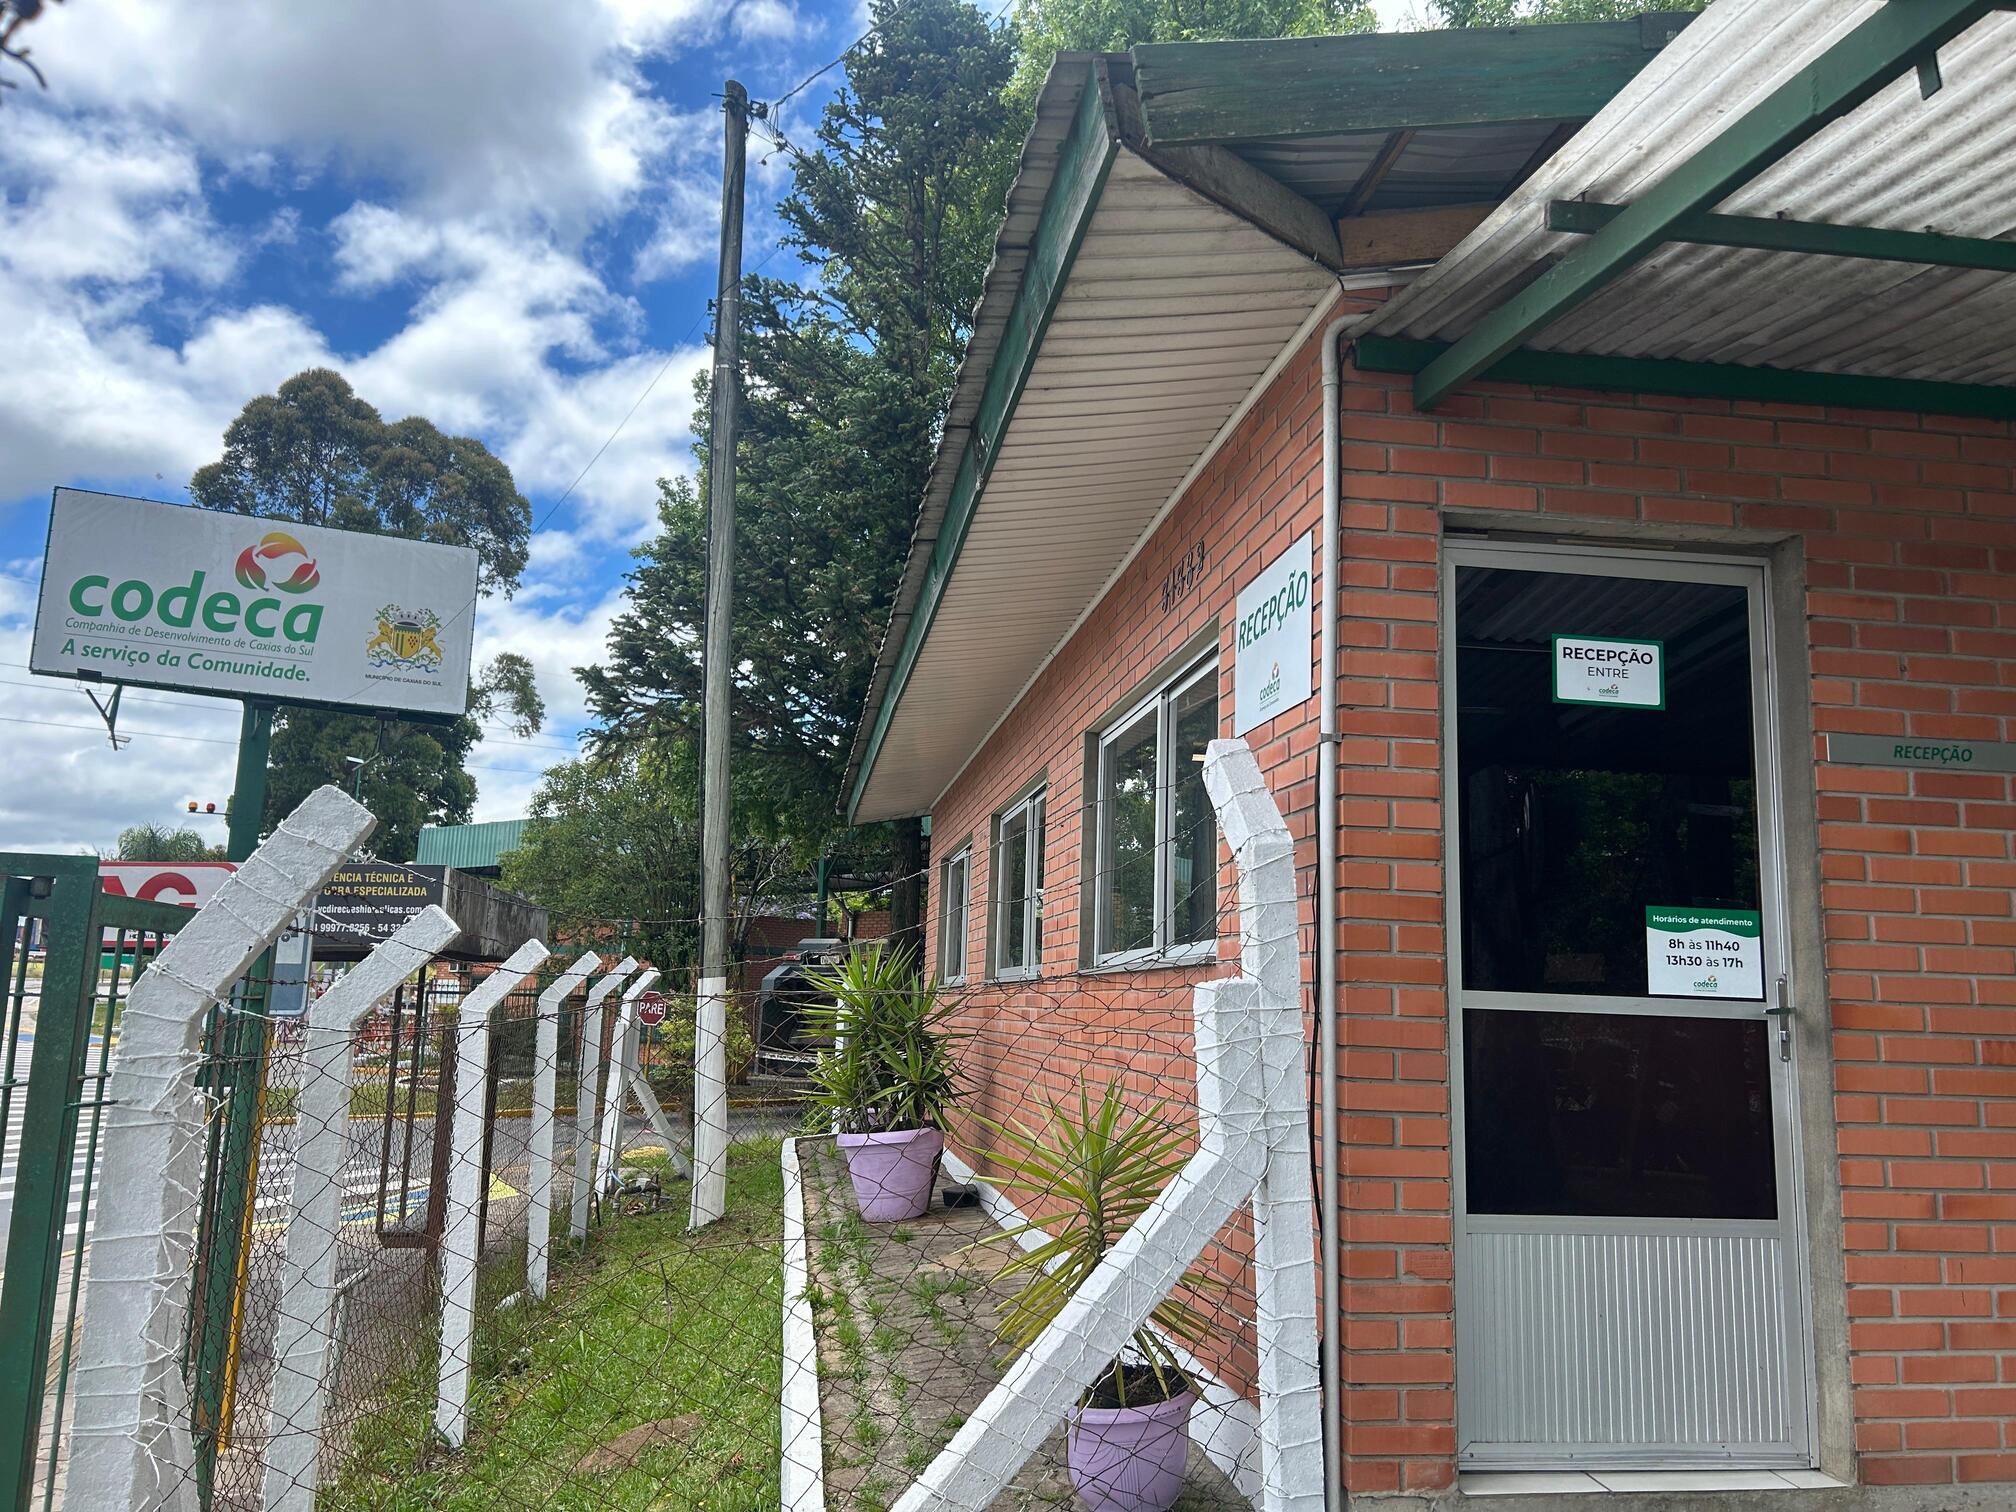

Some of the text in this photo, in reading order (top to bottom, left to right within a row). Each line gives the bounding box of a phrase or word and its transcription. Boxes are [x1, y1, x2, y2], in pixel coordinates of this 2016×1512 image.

[69, 570, 324, 643] codeca
[1238, 569, 1308, 653] RECEPÇÃO
[65, 617, 315, 656] Companhia de Desenvolvimento de Caxias do Sul
[60, 638, 310, 682] A serviço da Comunidade.
[1562, 646, 1653, 667] RECEPÇÃO
[1587, 666, 1630, 679] ENTRE
[1260, 679, 1280, 701] codeca
[1893, 745, 1973, 765] RECEPÇÃO
[365, 871, 405, 883] TÉCNICA
[407, 873, 414, 882] E
[353, 886, 427, 897] ESPECIALIZADA
[1652, 915, 1753, 927] Horários de atendimento
[1668, 939, 1740, 951] 8h às 11h40
[1666, 955, 1743, 968] 13h30 às 17h
[1693, 980, 1718, 988] codeca
[639, 1002, 664, 1015] PARE
